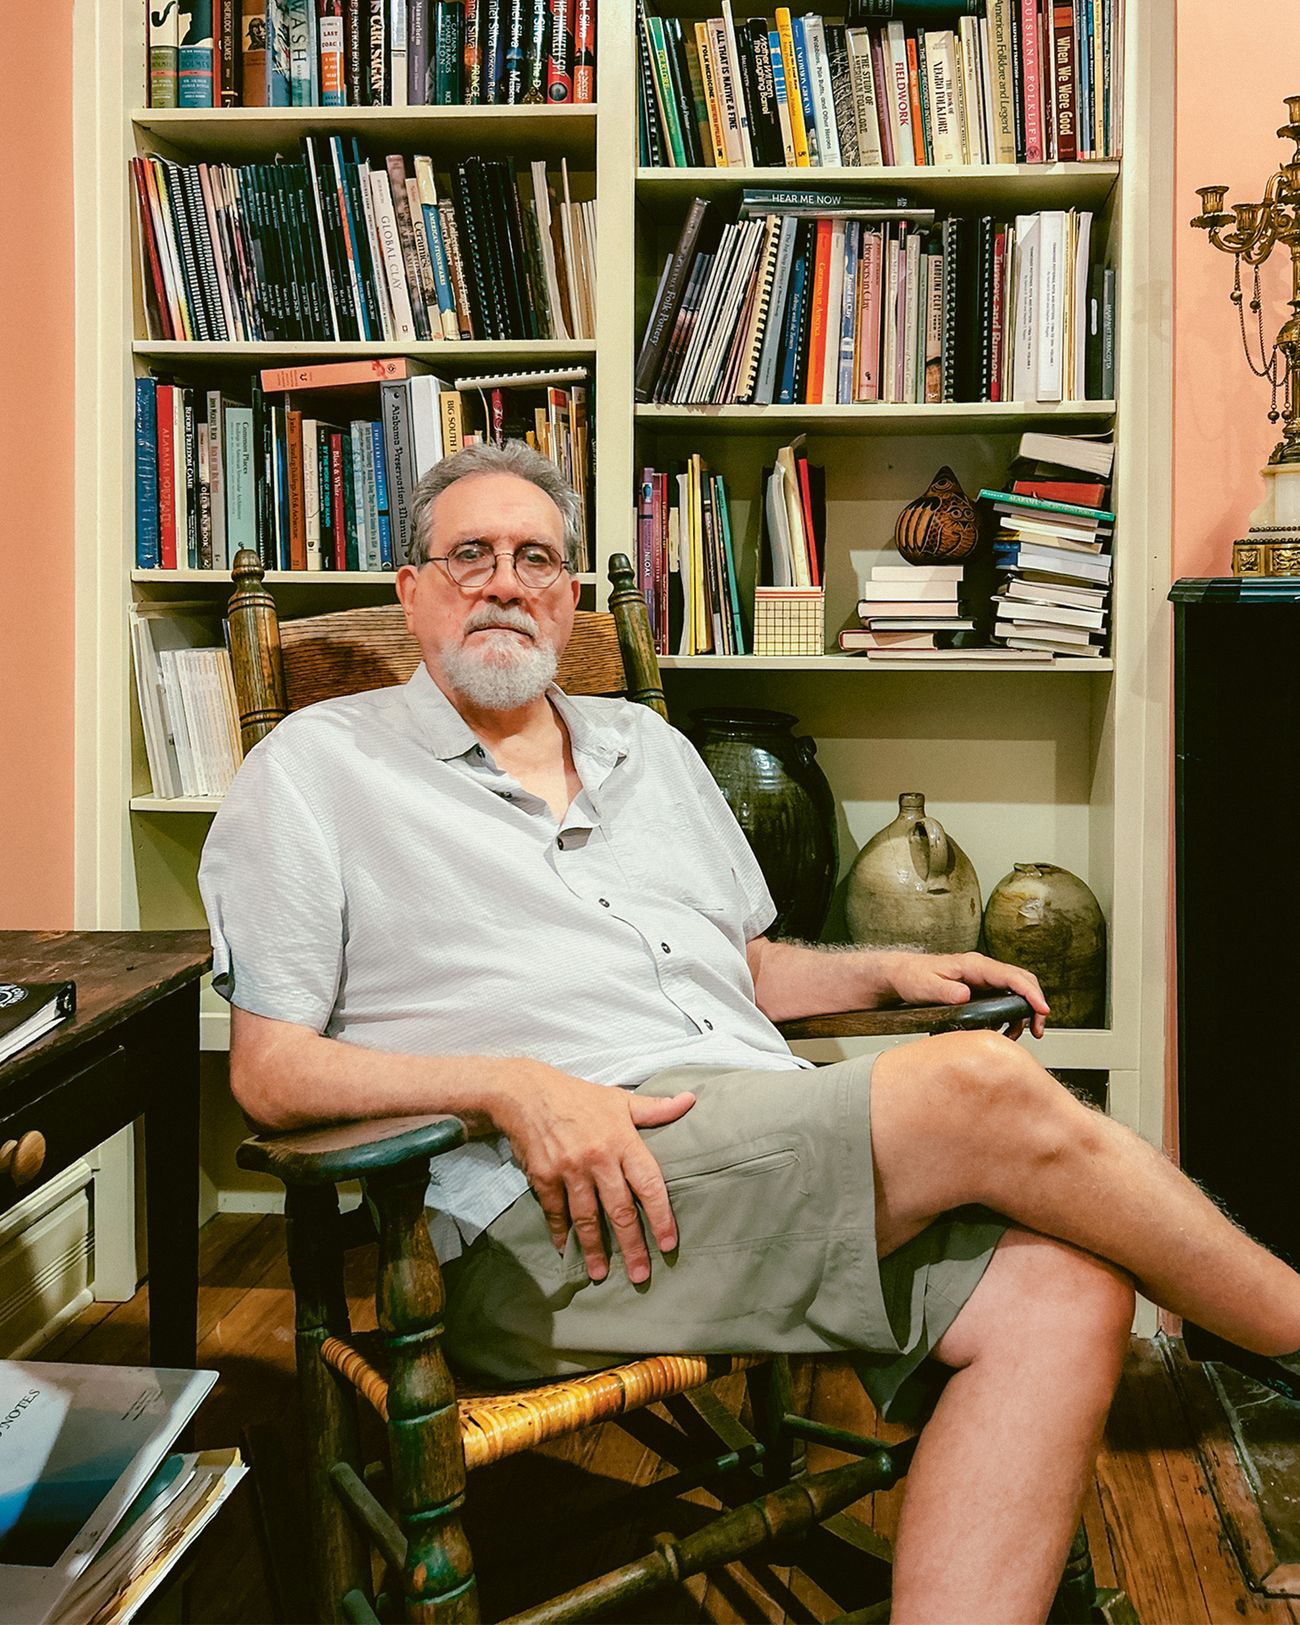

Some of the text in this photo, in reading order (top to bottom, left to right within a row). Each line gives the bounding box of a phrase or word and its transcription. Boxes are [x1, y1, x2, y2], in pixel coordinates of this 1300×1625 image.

[224, 1, 232, 60] SHERLOCK HOLMES
[349, 8, 360, 72] JUNCTION BOYS
[467, 25, 477, 49] Silva
[488, 23, 498, 47] Silva
[510, 24, 522, 48] Silva
[533, 18, 545, 43] Silva
[579, 13, 590, 38] Silva
[716, 29, 725, 44] ALL
[370, 15, 384, 90] CARL SAGAN
[552, 15, 567, 76] UNLIKELY SPY
[701, 45, 710, 63] FOLK
[718, 45, 729, 65] THAT
[753, 40, 762, 53] the
[487, 49, 496, 102] Moscow Rules
[657, 49, 670, 89] FOLKLORE
[721, 67, 730, 75] IS
[754, 54, 768, 91] Laughing
[759, 34, 775, 98] Mother Wit from
[996, 44, 1010, 80] Folklore
[471, 64, 480, 97] PRINCE
[507, 70, 520, 105] Messeng
[704, 64, 715, 99] MEDICINE
[723, 76, 734, 104] NATIVE
[796, 46, 811, 114] UNCOMMON GROUND
[853, 55, 867, 134] AMERICAN FOLKLORE
[861, 54, 873, 106] THE STUDY OF
[895, 62, 909, 126] FIELDWORK
[999, 81, 1010, 100] and
[1057, 36, 1073, 136] When We Were Good
[760, 92, 770, 115] Barrel
[820, 97, 828, 109] and
[933, 61, 948, 135] NEGRO FOLKLORE
[1026, 75, 1037, 144] FOLKLIFE
[728, 112, 738, 130] FINE
[822, 110, 830, 128] Other
[1000, 100, 1011, 134] Legend
[824, 128, 832, 149] Heroes
[446, 207, 456, 222] The
[772, 194, 841, 205] HEAR ME NOW
[428, 211, 440, 244] AMERICAN
[380, 215, 402, 290] GLOBAL CLAY
[413, 221, 430, 269] Ceramics
[443, 238, 454, 266] Pottery
[455, 262, 466, 281] Book
[458, 280, 467, 288] of
[816, 262, 826, 296] Ceramics
[846, 274, 854, 295] Raised
[862, 243, 873, 311] Brothers in Clay
[933, 259, 943, 311] CAROLINA CLAY
[459, 288, 472, 317] English
[661, 290, 677, 312] Folk
[845, 302, 853, 319] Clay
[992, 304, 1001, 329] and
[650, 313, 670, 346] Pottery
[814, 306, 823, 337] America
[447, 400, 458, 447] BIG SOUTH
[184, 406, 194, 489] BEFORE FREEDOM CAME
[322, 446, 328, 454] BY
[332, 450, 340, 467] Black
[162, 428, 171, 528] ALABAMA PORTRAITS
[242, 454, 250, 475] Places
[391, 404, 409, 547] Alabama Preservation Manual
[324, 483, 330, 491] OF
[200, 486, 210, 547] OLD BARN BOOK
[644, 551, 652, 577] NILOAK
[0, 1389, 40, 1430] NOTES
